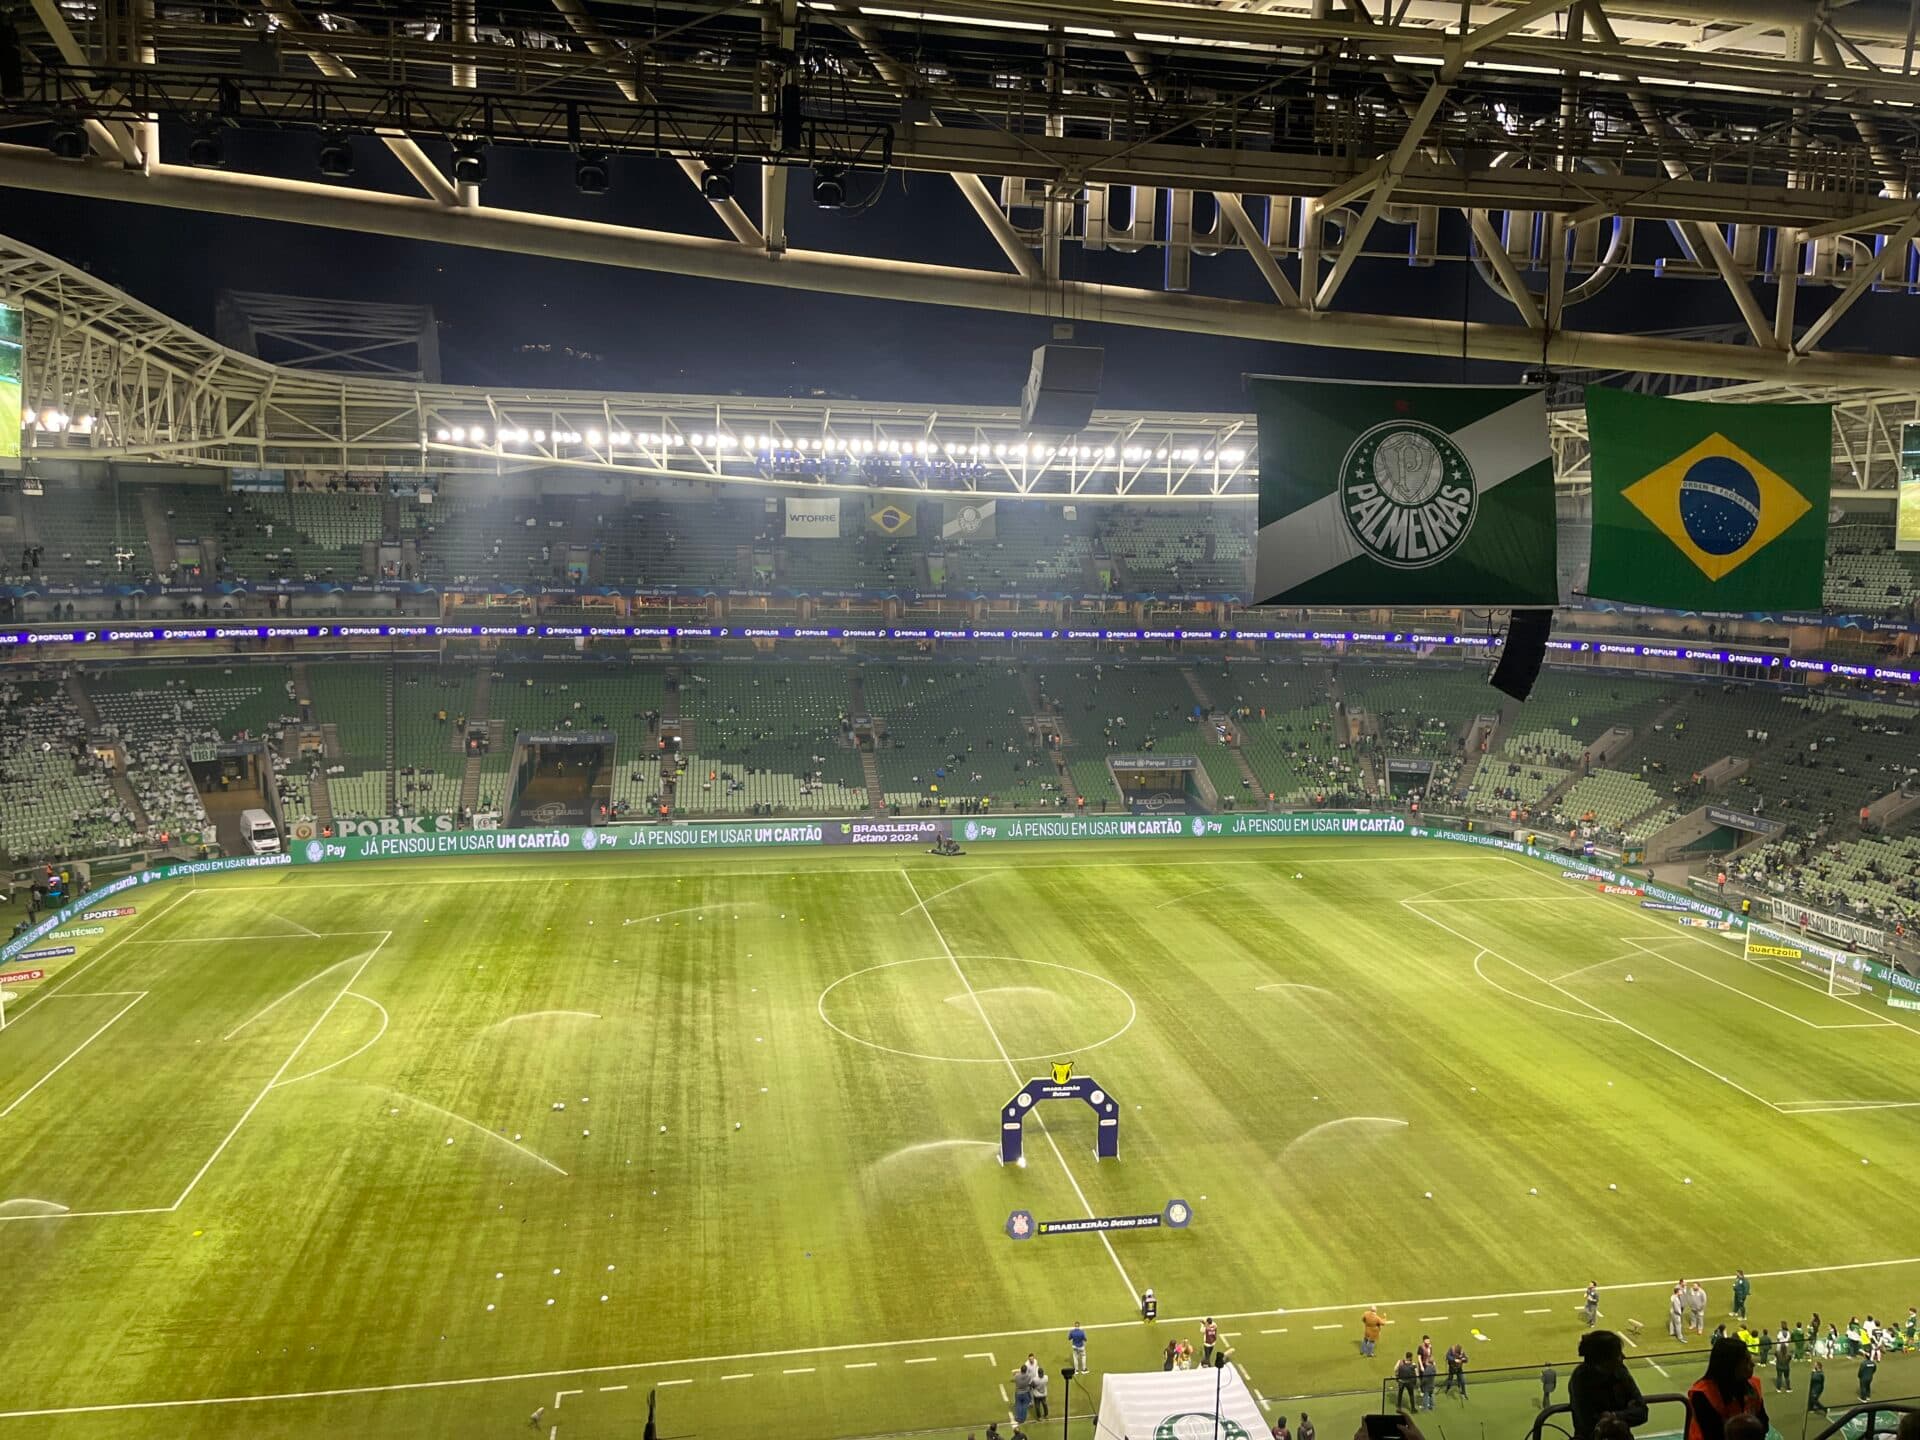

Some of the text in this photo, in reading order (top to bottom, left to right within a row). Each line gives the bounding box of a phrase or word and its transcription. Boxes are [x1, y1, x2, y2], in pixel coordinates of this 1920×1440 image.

[789, 514, 836, 523] WTORRE
[1348, 482, 1471, 559] PALMEIRAS
[852, 822, 936, 832] BRASILEIRÃO
[1008, 818, 1182, 836] JÁ PENSOU EM USAR UM CARTÃO
[1208, 821, 1222, 833] Pay
[1232, 816, 1404, 832] JÁ PENSOU EM USAR UM CARTÃO
[630, 825, 822, 845] JÁ PENSOU EM USAR UM CARTÃO
[852, 833, 918, 844] Betano 2024
[981, 826, 996, 838] Pay
[360, 831, 570, 856] JÁ PENSOU EM USAR UM CARTÃO
[600, 834, 618, 846] Pay
[327, 844, 346, 858] Pay
[168, 855, 292, 876] JÁ PENSOU EM USAR UM CARTÃO
[49, 927, 104, 940] GRAU TÉCNICO
[1749, 944, 1799, 958] quartzolit
[1048, 1218, 1109, 1232] BRASILEIRÃO
[1137, 1217, 1158, 1226] 2024
